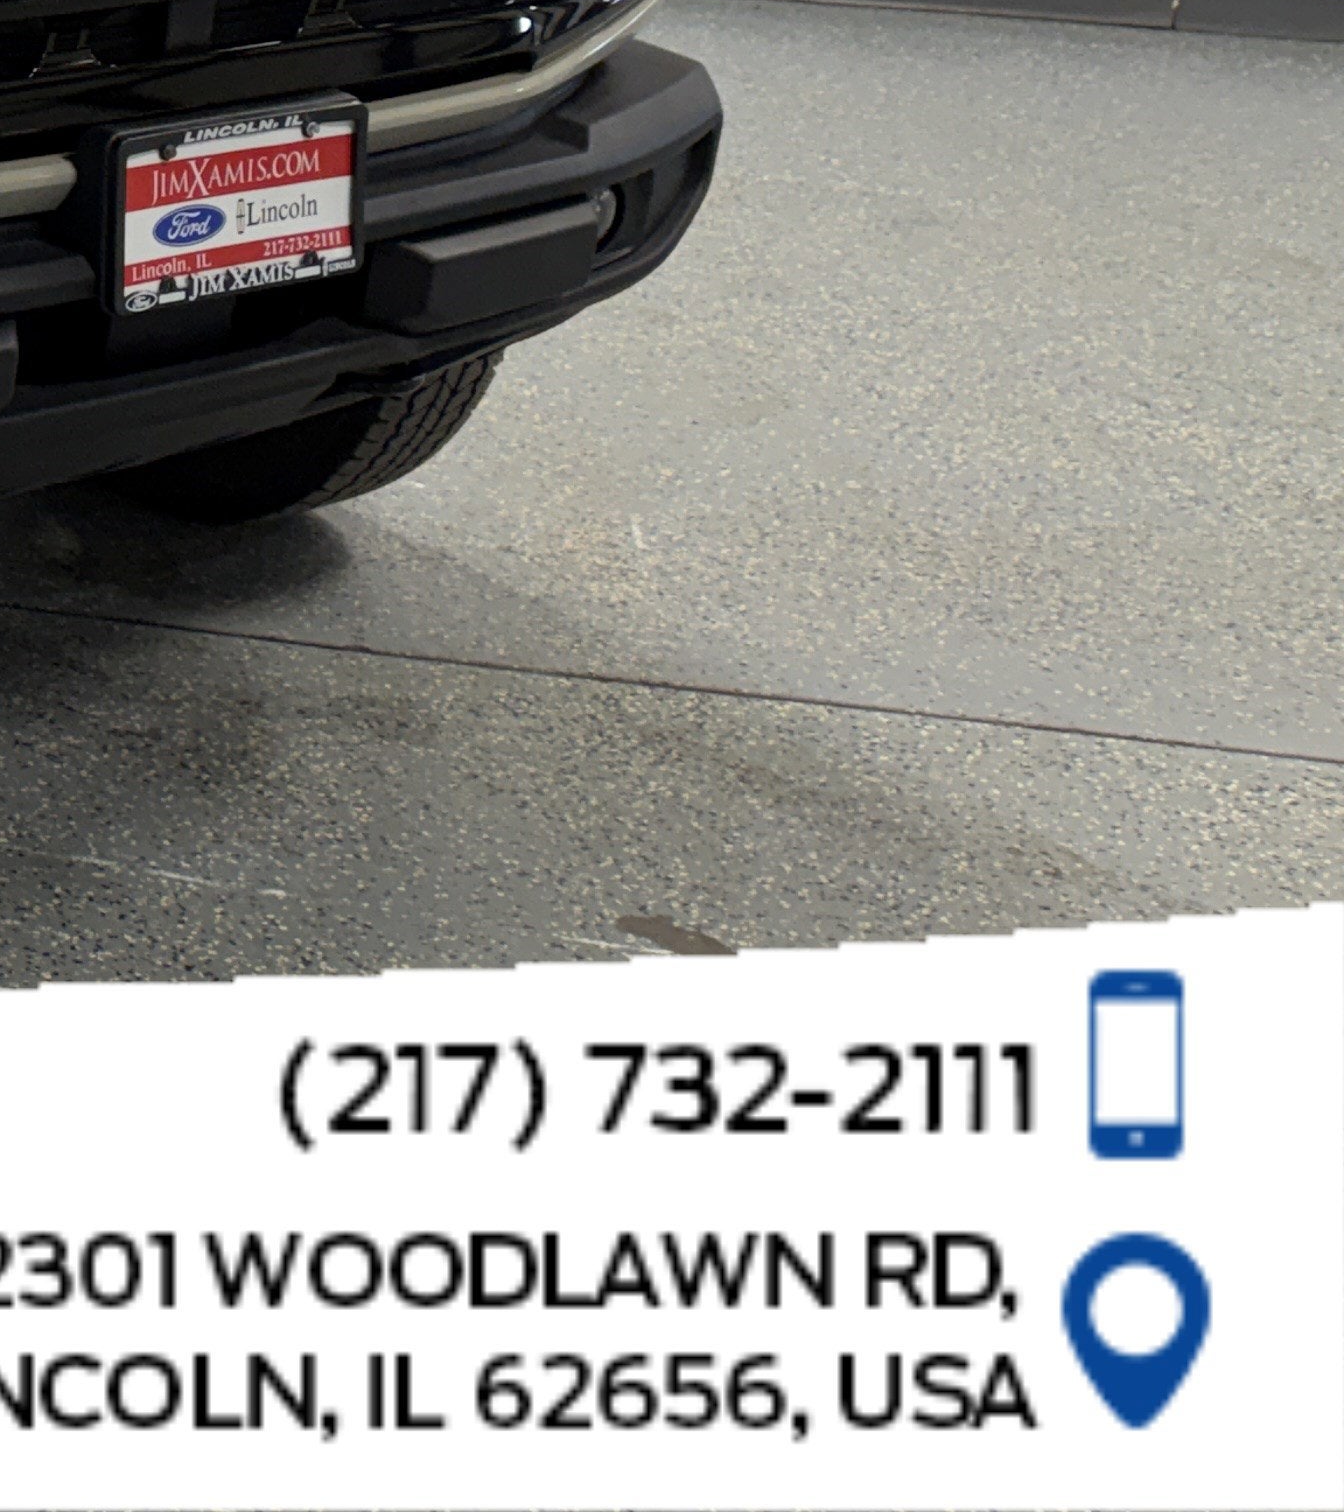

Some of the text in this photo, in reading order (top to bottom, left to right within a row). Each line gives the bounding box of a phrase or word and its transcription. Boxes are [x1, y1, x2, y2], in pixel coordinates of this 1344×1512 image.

[285, 114, 304, 127] IL
[246, 193, 318, 227] Lincoln
[167, 210, 210, 240] Ford
[263, 230, 342, 257] 217-732-2111
[195, 254, 212, 269] IL
[188, 263, 295, 301] JIM XAMIS
